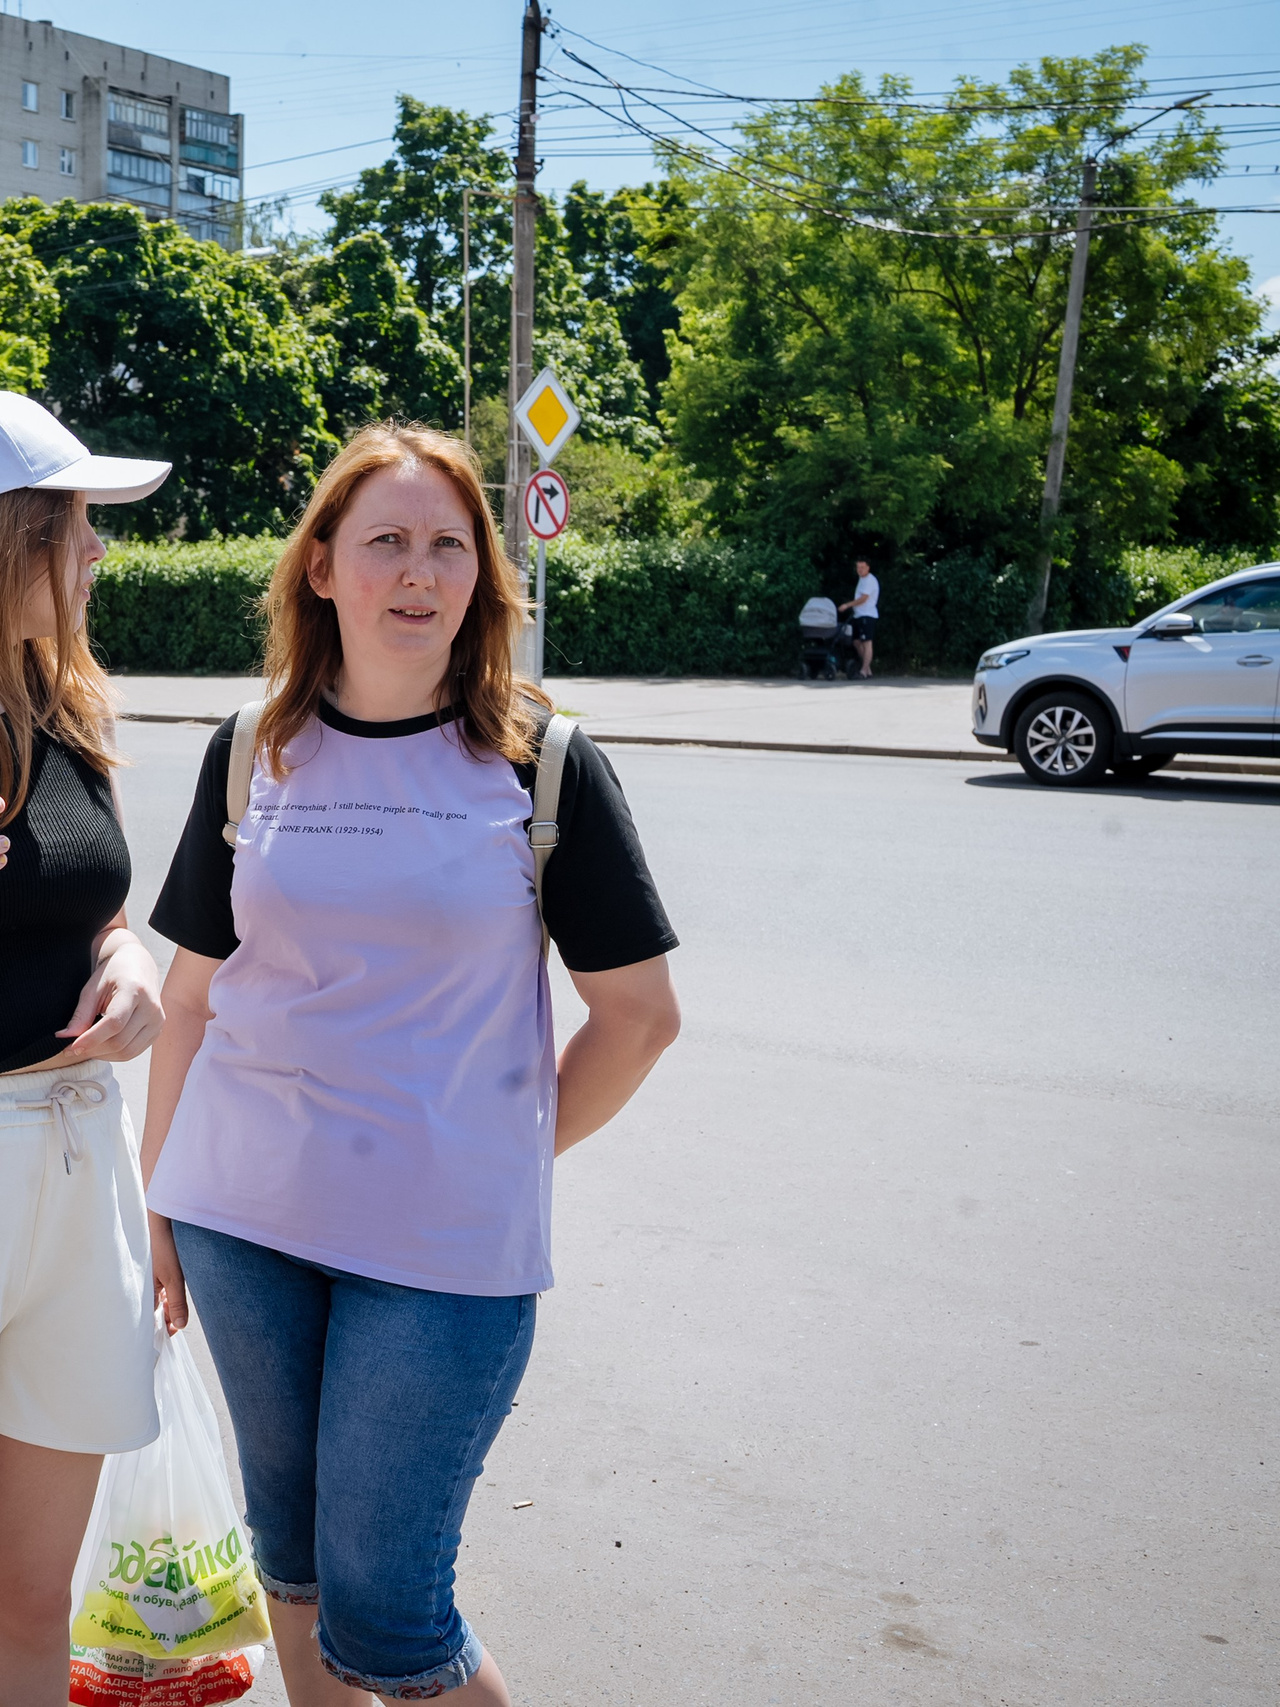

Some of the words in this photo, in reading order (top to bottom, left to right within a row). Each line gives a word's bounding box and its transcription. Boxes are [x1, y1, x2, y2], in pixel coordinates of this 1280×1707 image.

[263, 803, 280, 812] spite
[281, 803, 290, 811] of
[338, 802, 354, 811] still
[354, 803, 382, 811] believe
[422, 810, 444, 820] really
[445, 812, 468, 821] good
[302, 826, 333, 834] FRANK
[335, 826, 384, 836] (1929-1954)
[133, 1594, 140, 1602] и
[210, 1580, 231, 1596] для
[231, 1563, 248, 1584] дома
[101, 1620, 146, 1639] Курск,
[149, 1632, 170, 1641] ул.
[246, 1591, 257, 1606] 20
[162, 1655, 214, 1675] ПРИЛОЕНИЕ
[70, 1664, 102, 1683] НАШИ
[169, 1666, 231, 1689] Мендлеева
[168, 1691, 184, 1700] ул.
